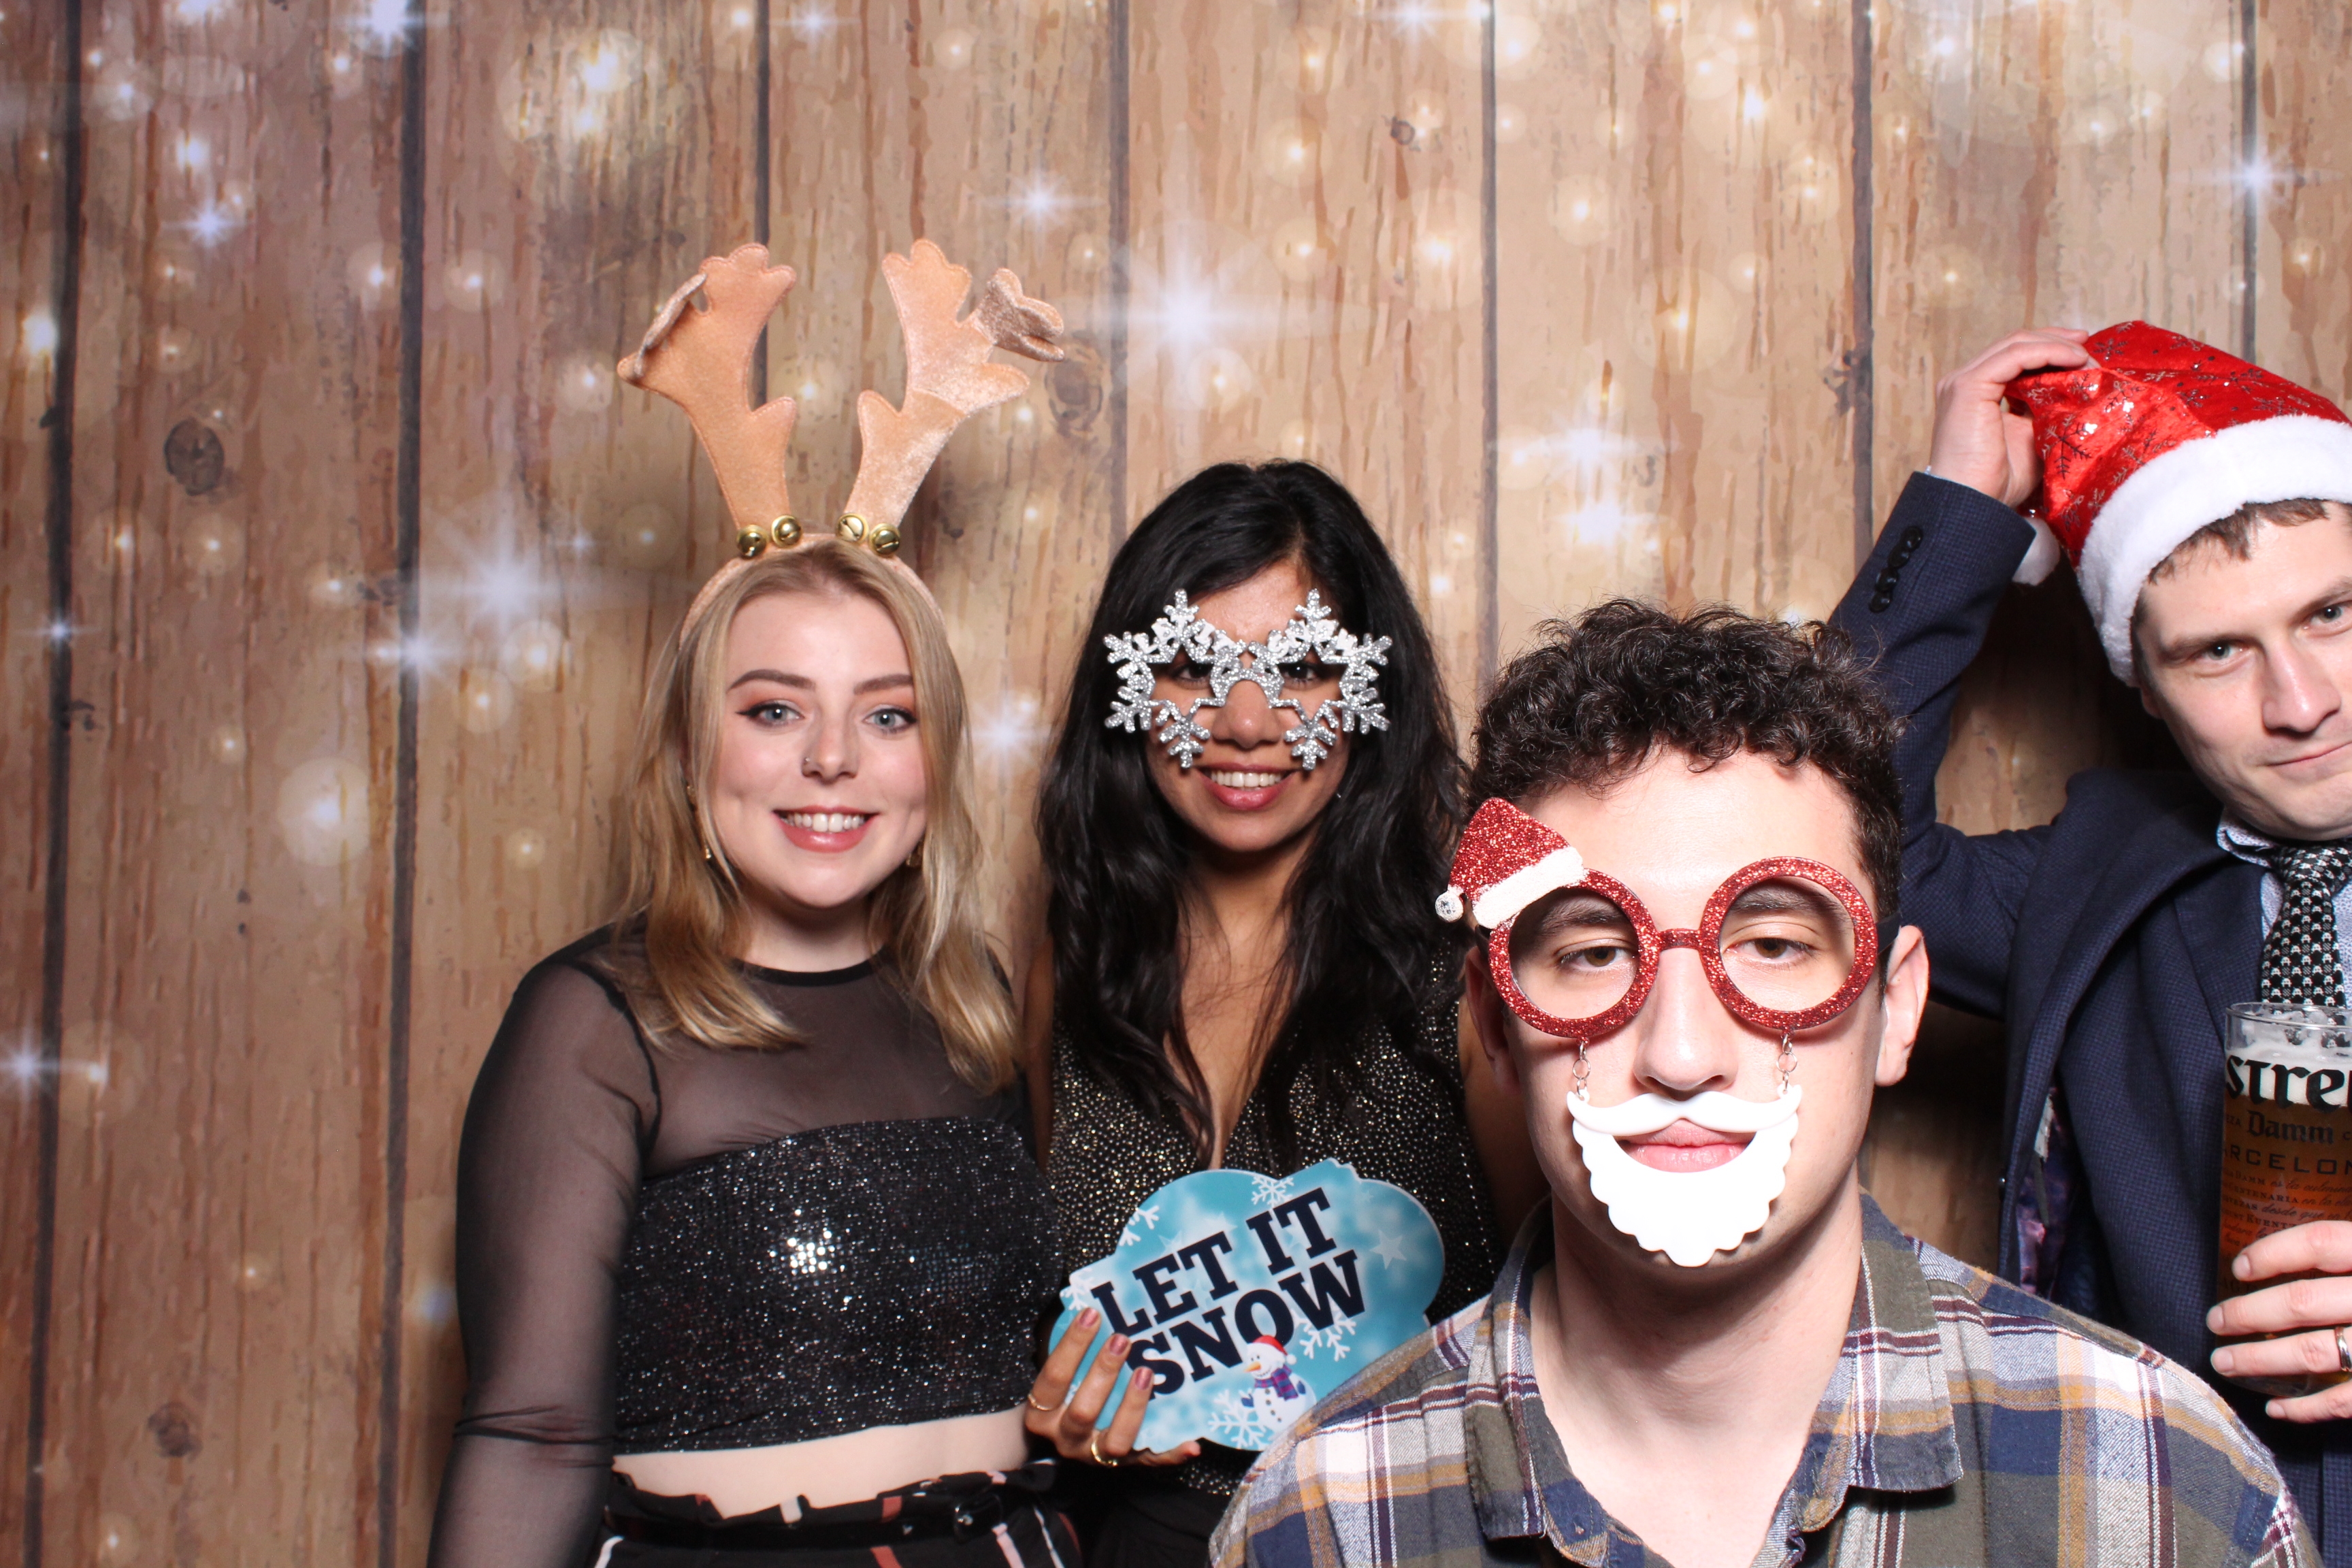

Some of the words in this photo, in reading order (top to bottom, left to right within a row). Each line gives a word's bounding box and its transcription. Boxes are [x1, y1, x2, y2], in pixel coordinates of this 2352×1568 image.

[2225, 1145, 2352, 1175] RCELO
[2247, 1109, 2334, 1144] Damm
[1091, 1231, 1239, 1337] LET
[1245, 1187, 1338, 1275] IT
[1127, 1249, 1365, 1401] SNOW
